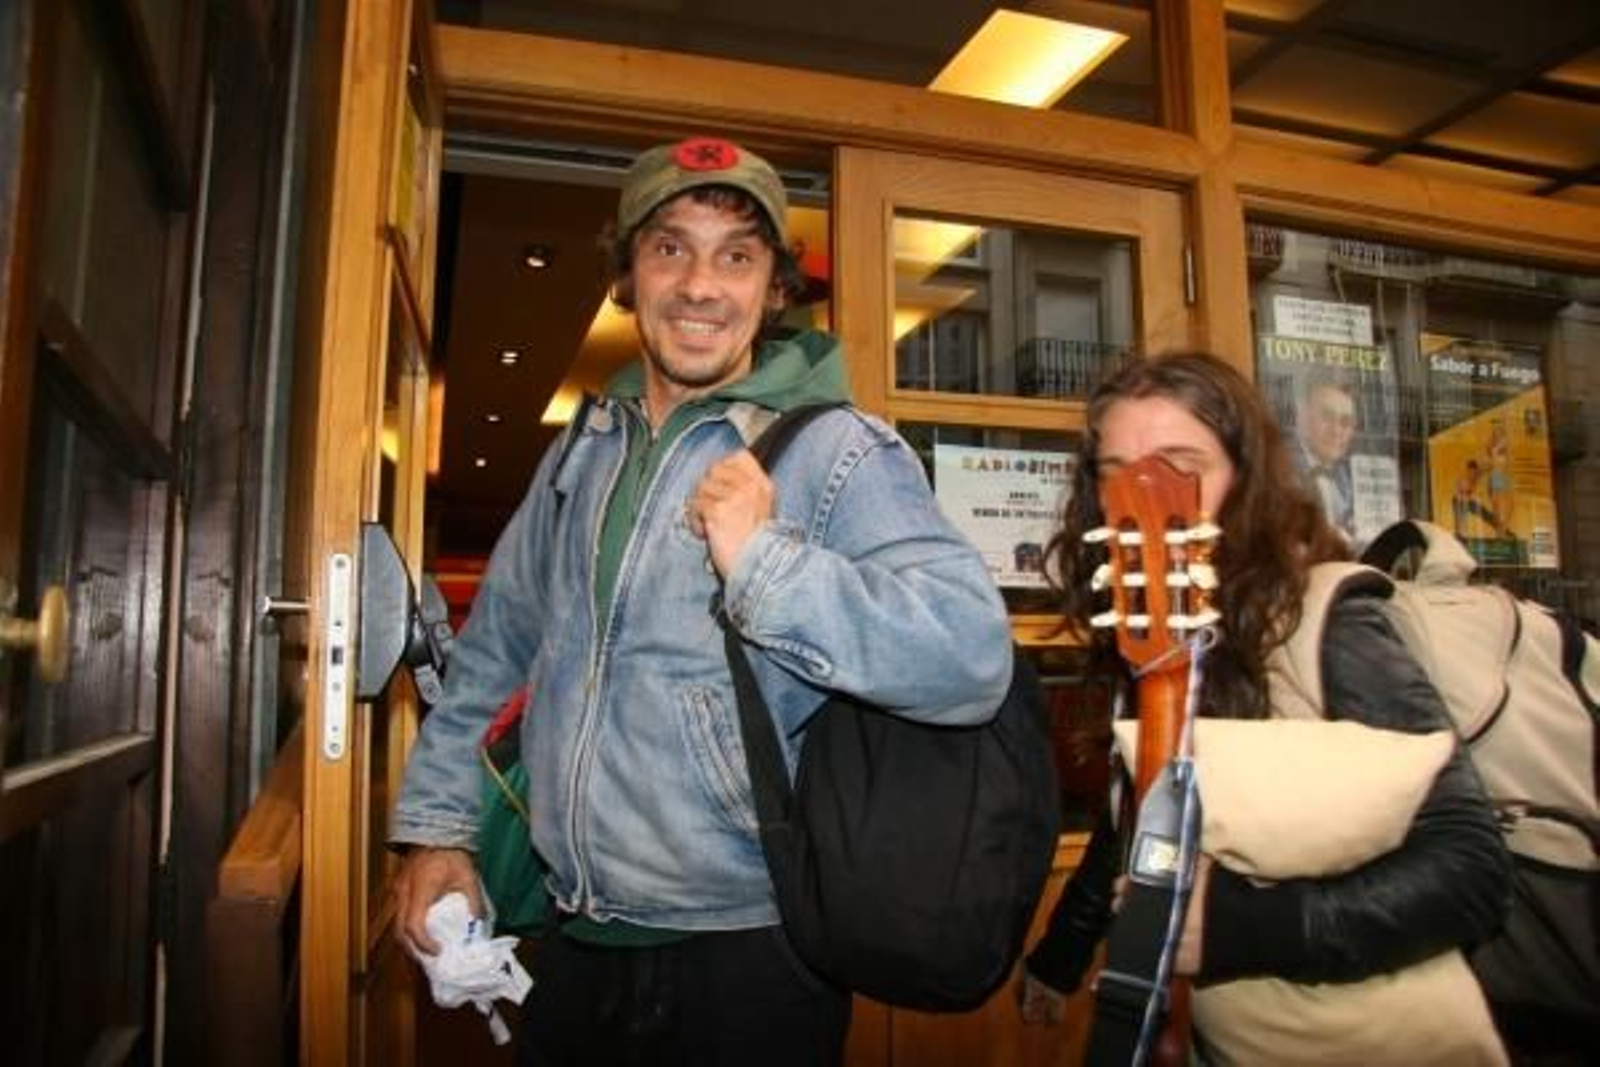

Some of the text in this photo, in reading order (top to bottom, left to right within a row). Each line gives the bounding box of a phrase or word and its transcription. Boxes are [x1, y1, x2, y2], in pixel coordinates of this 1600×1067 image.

[1261, 337, 1316, 363] TONY
[1430, 353, 1540, 384] Sabor a Fuego
